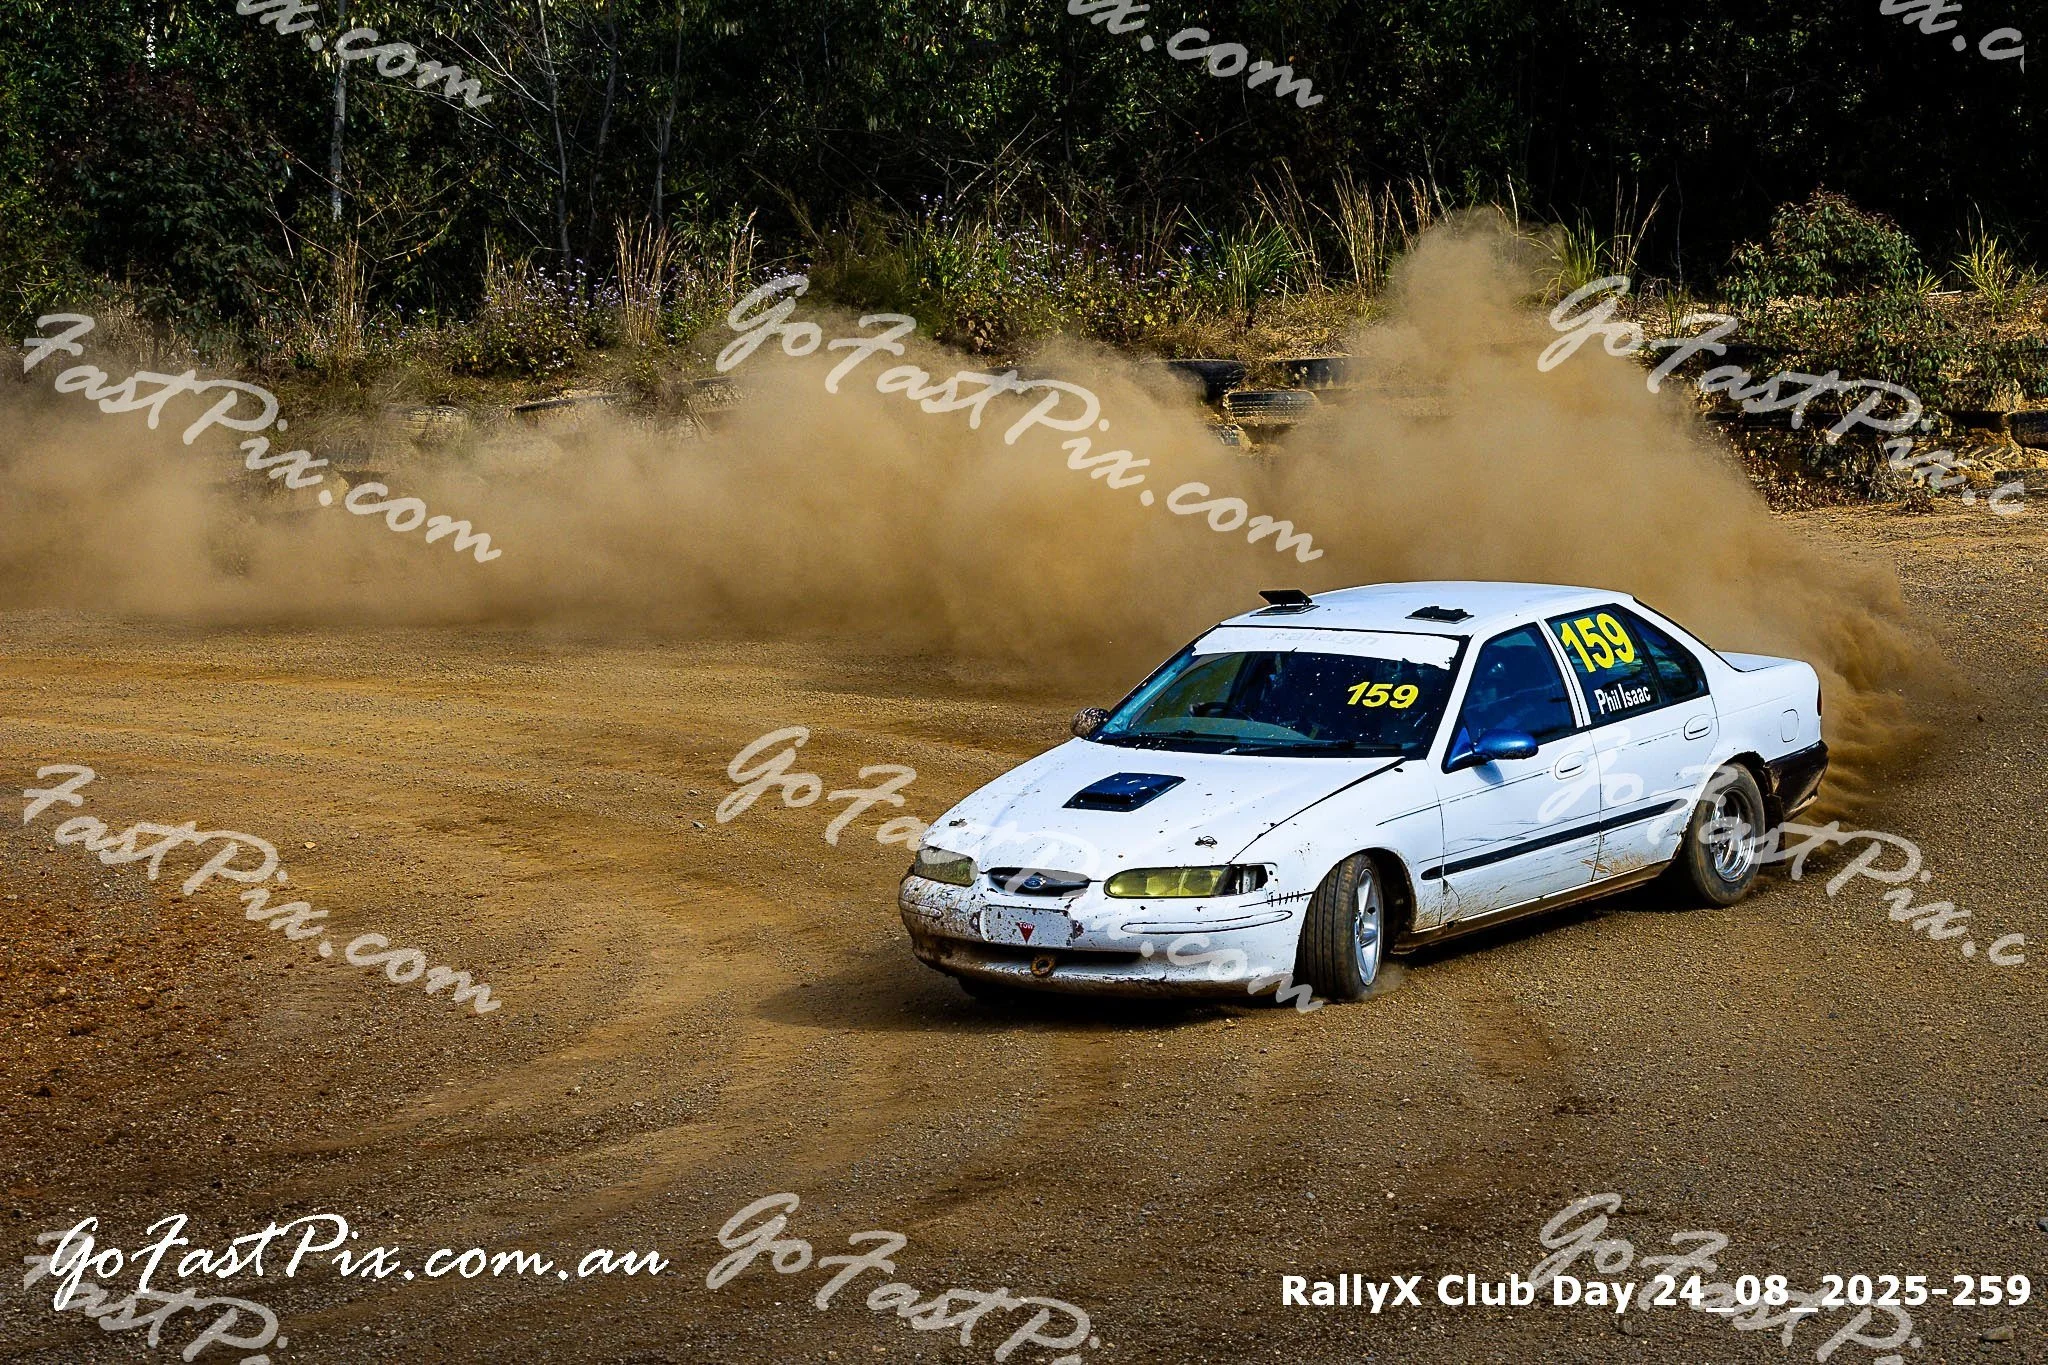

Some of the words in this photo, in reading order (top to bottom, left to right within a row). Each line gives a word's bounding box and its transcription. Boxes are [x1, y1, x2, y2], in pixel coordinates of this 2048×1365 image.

[1560, 613, 1634, 673] 159
[1347, 681, 1419, 709] 159
[1594, 686, 1622, 714] Phil
[1617, 683, 1651, 709] Isaac
[1019, 922, 1034, 930] TOW
